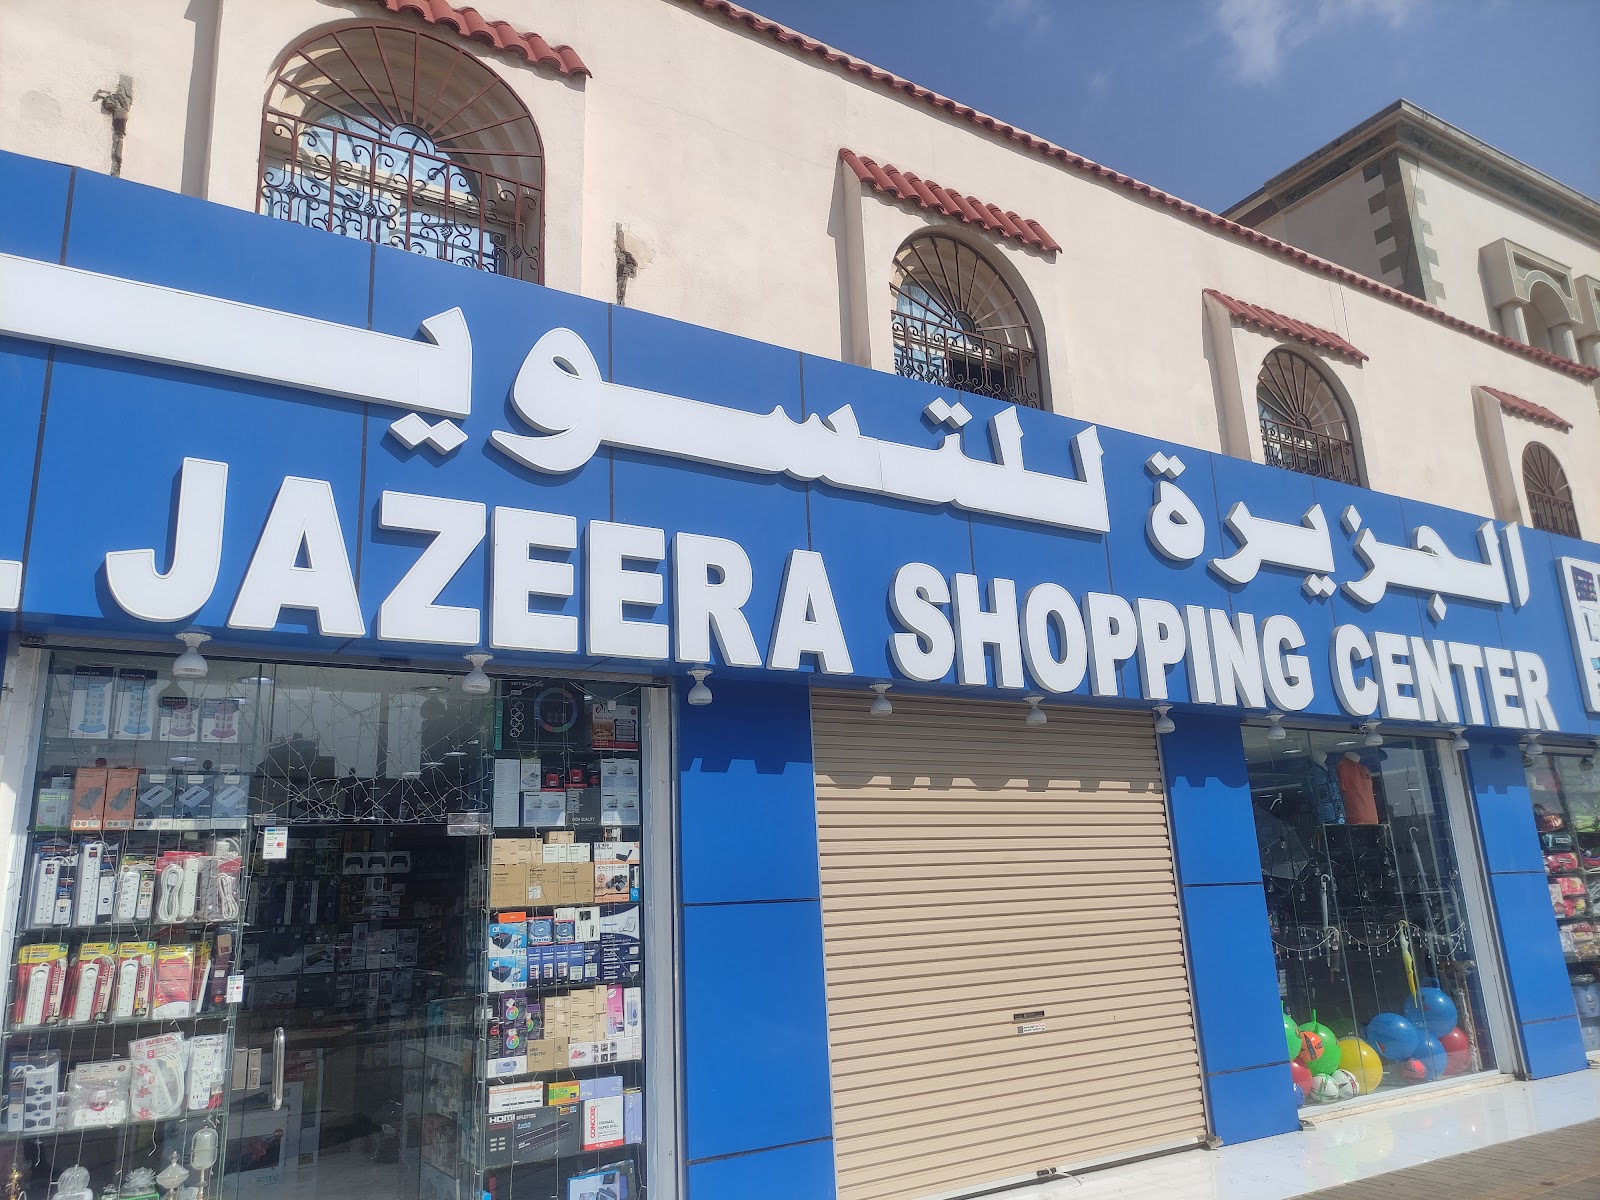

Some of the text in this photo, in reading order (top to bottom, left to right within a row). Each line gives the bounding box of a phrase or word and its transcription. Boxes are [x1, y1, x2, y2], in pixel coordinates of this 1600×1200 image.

[0, 252, 1530, 623] الجزيرة للتسوي
[105, 456, 1560, 732] JAZEERA SHOPPING CENTER
[489, 1113, 516, 1124] HDMI
